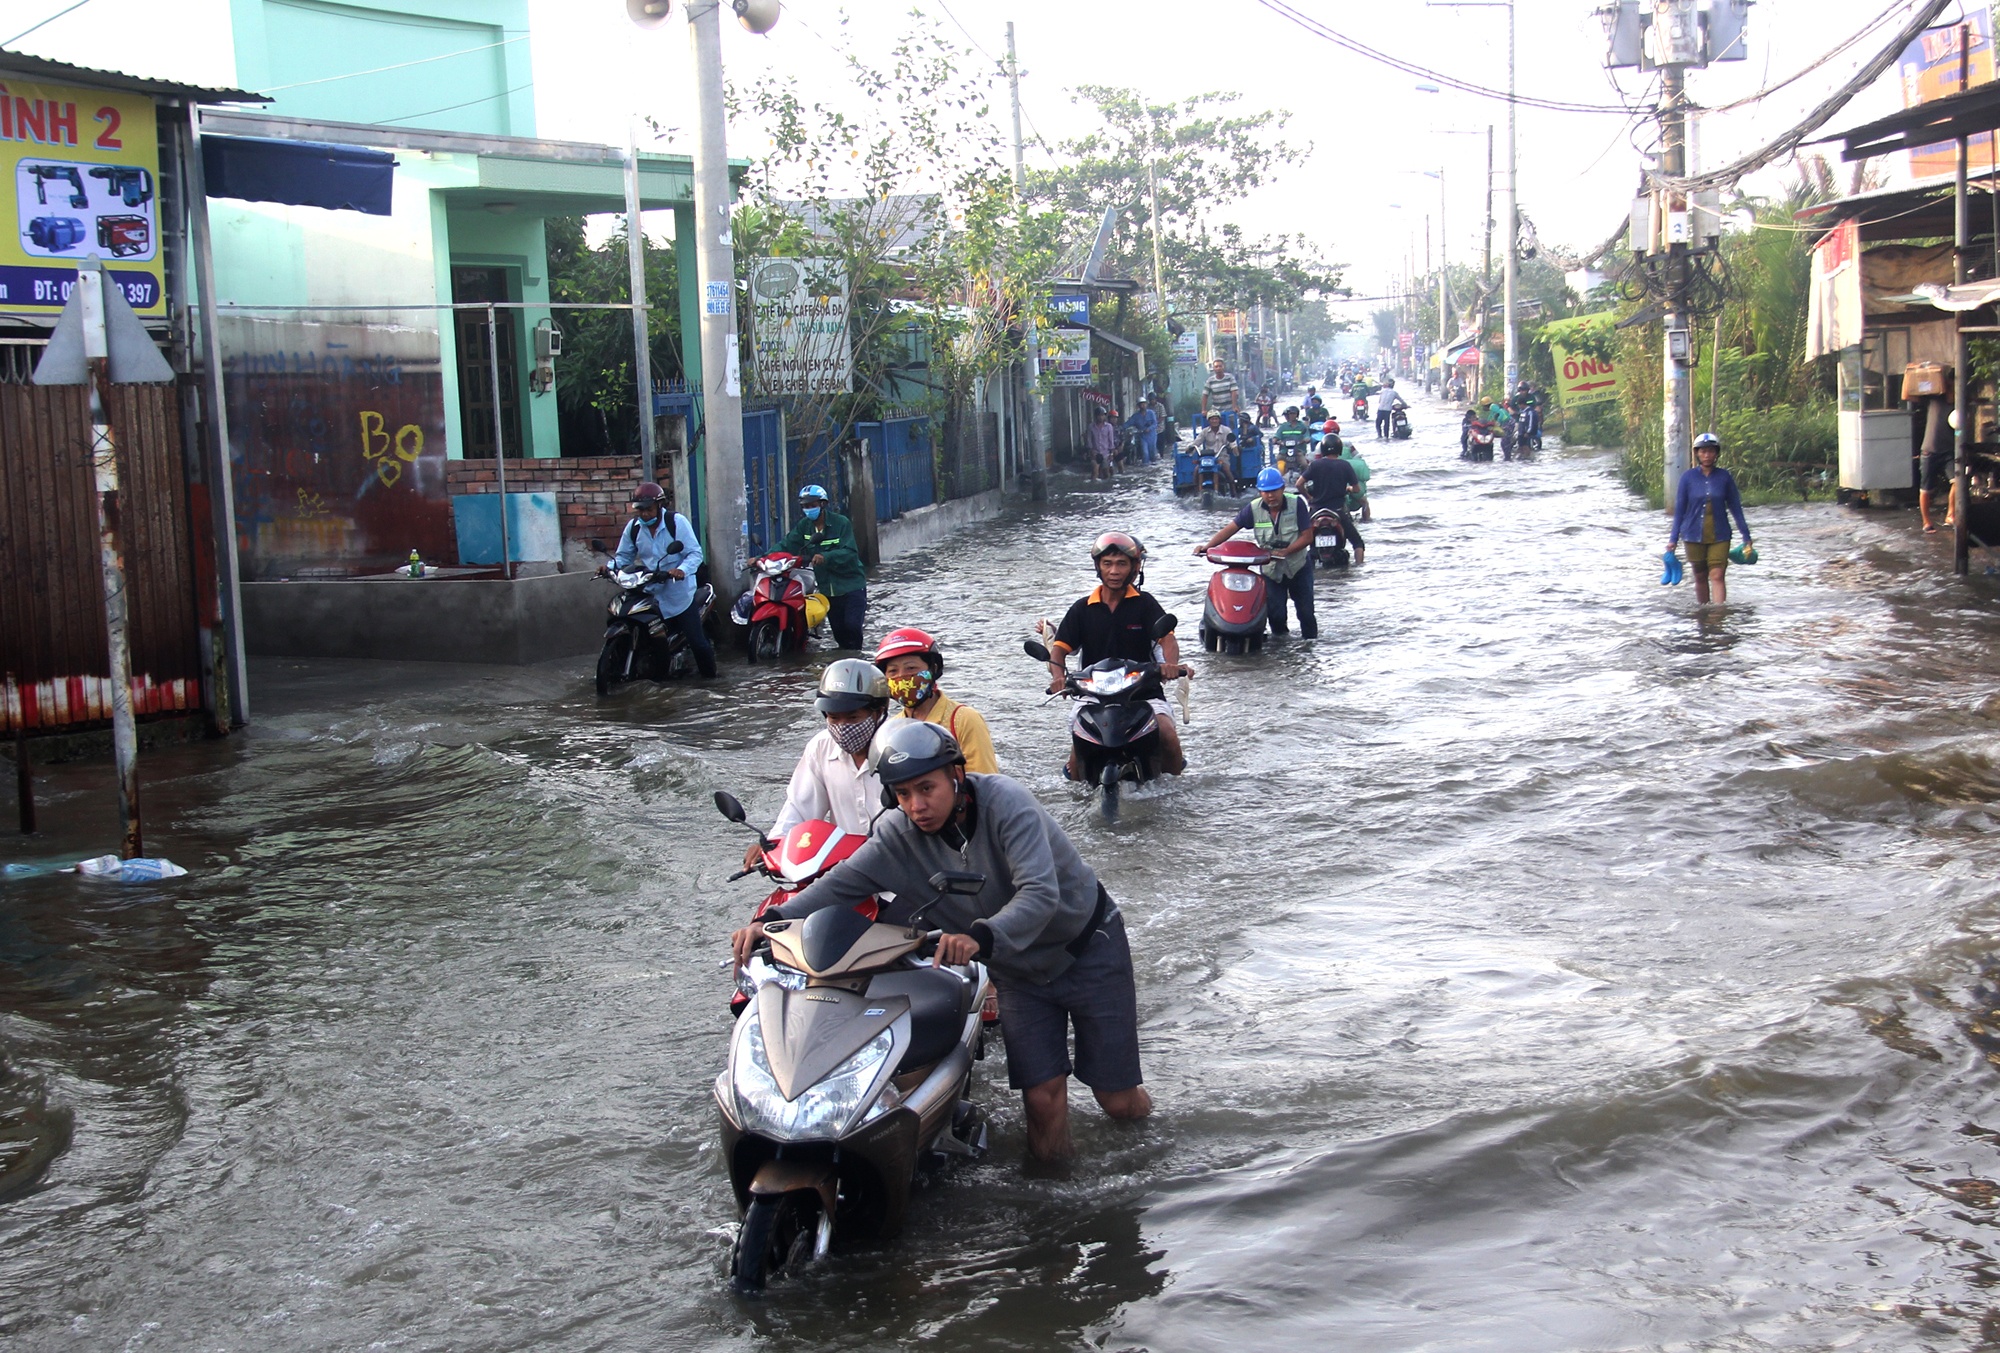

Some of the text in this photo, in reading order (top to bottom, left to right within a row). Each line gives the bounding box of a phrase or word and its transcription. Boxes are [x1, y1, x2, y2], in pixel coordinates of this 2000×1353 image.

[94, 106, 122, 150] 2
[128, 283, 152, 303] 397
[806, 994, 840, 1003] HONDA
